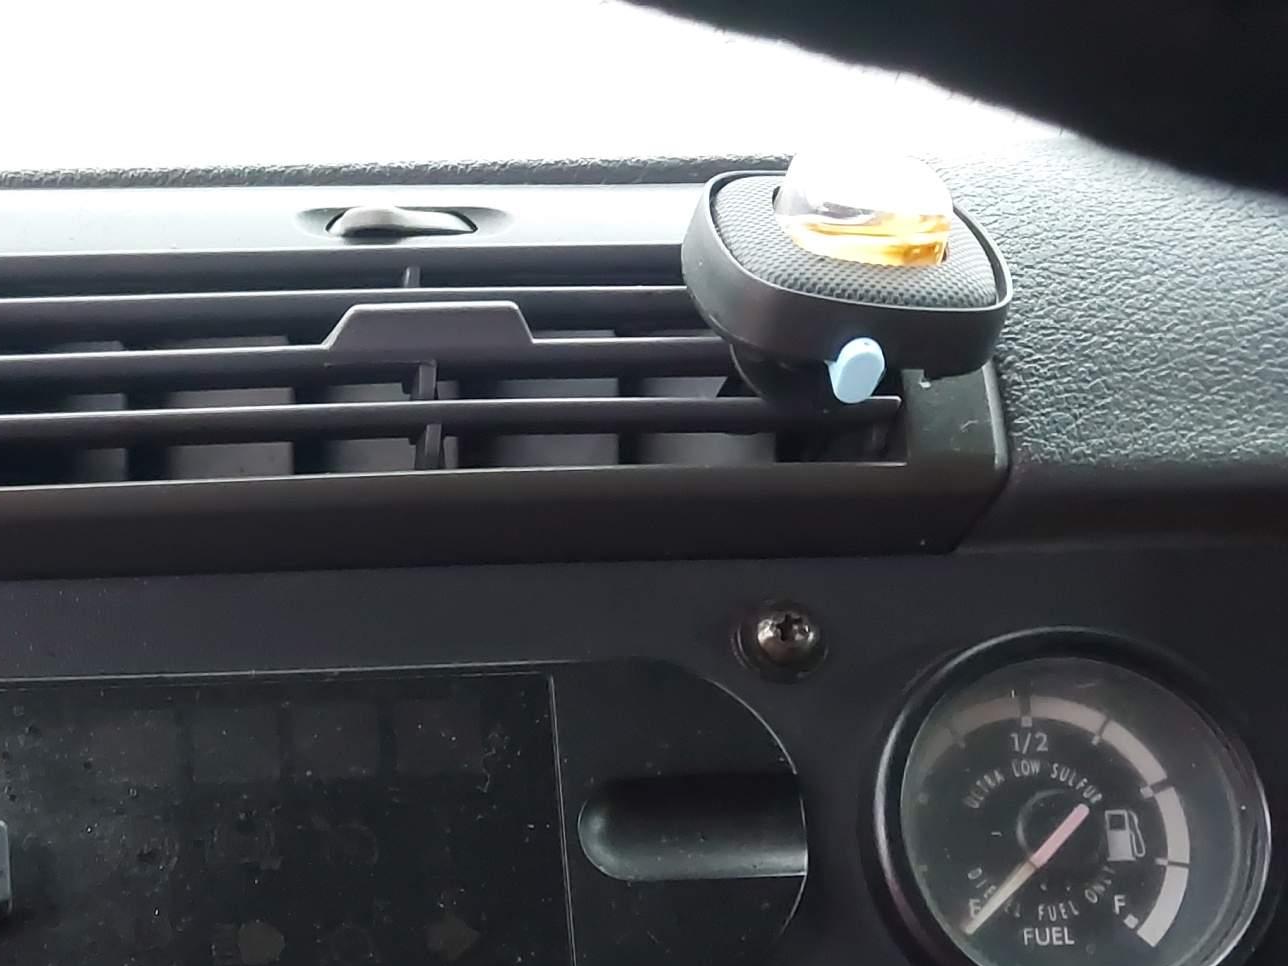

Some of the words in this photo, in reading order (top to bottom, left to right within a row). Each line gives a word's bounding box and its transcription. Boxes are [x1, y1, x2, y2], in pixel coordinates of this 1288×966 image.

[1011, 732, 1048, 754] 1/2
[964, 769, 1005, 809] ULTRA
[1012, 759, 1041, 777] LOW
[1050, 763, 1103, 803] SULFUR
[1038, 900, 1079, 921] FUEL
[1084, 865, 1115, 903] ONLY
[1114, 895, 1126, 914] F
[1023, 927, 1075, 945] FUEL
